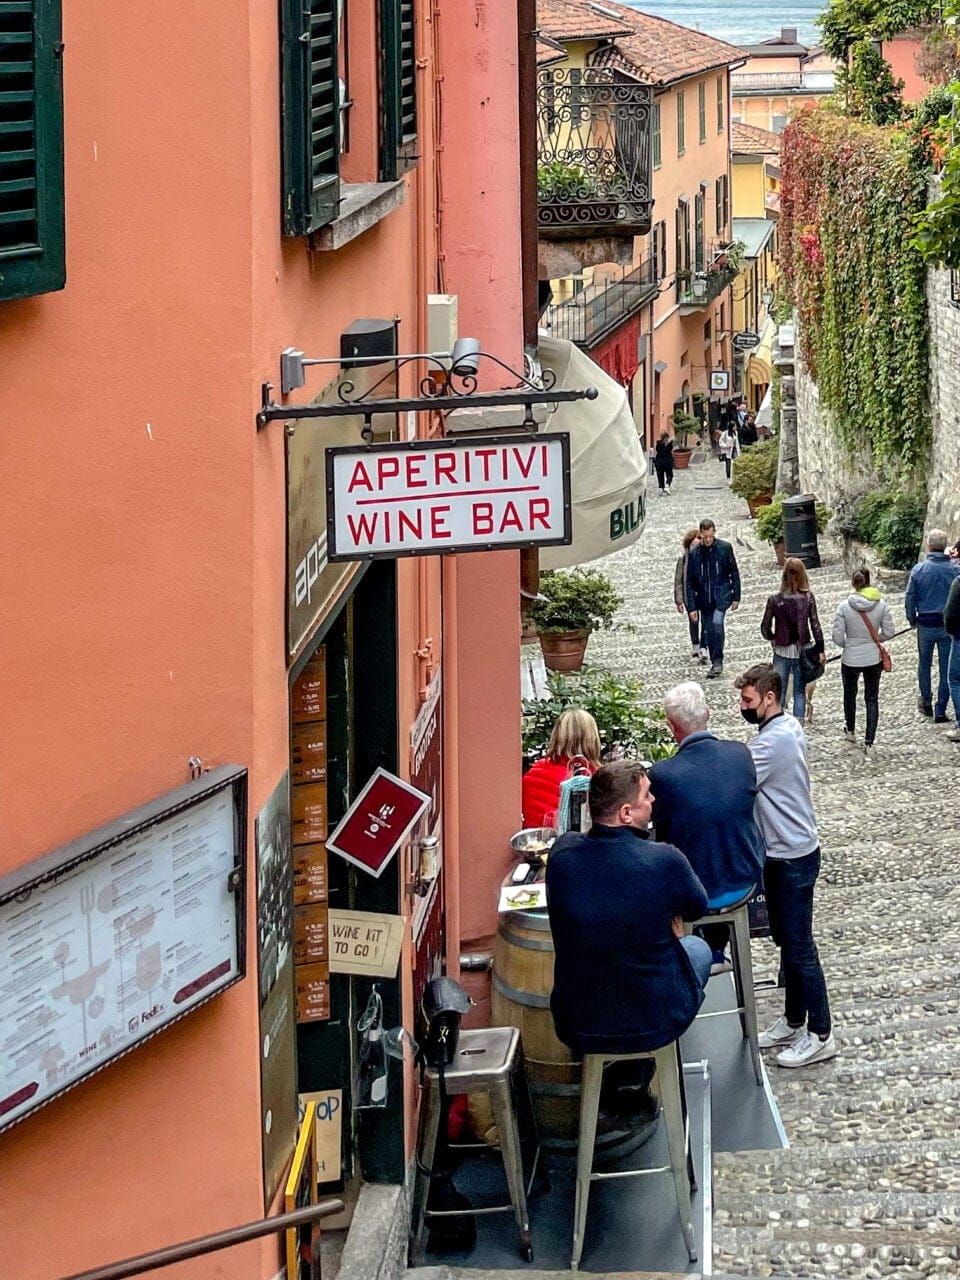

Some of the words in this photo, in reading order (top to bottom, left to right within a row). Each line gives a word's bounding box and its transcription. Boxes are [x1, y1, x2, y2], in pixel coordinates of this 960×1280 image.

[347, 446, 549, 493] APERITIVI
[346, 505, 451, 546] WINE
[472, 498, 552, 536] BAR
[335, 942, 348, 954] TO
[354, 944, 369, 957] GO
[298, 1096, 340, 1124] SOP
